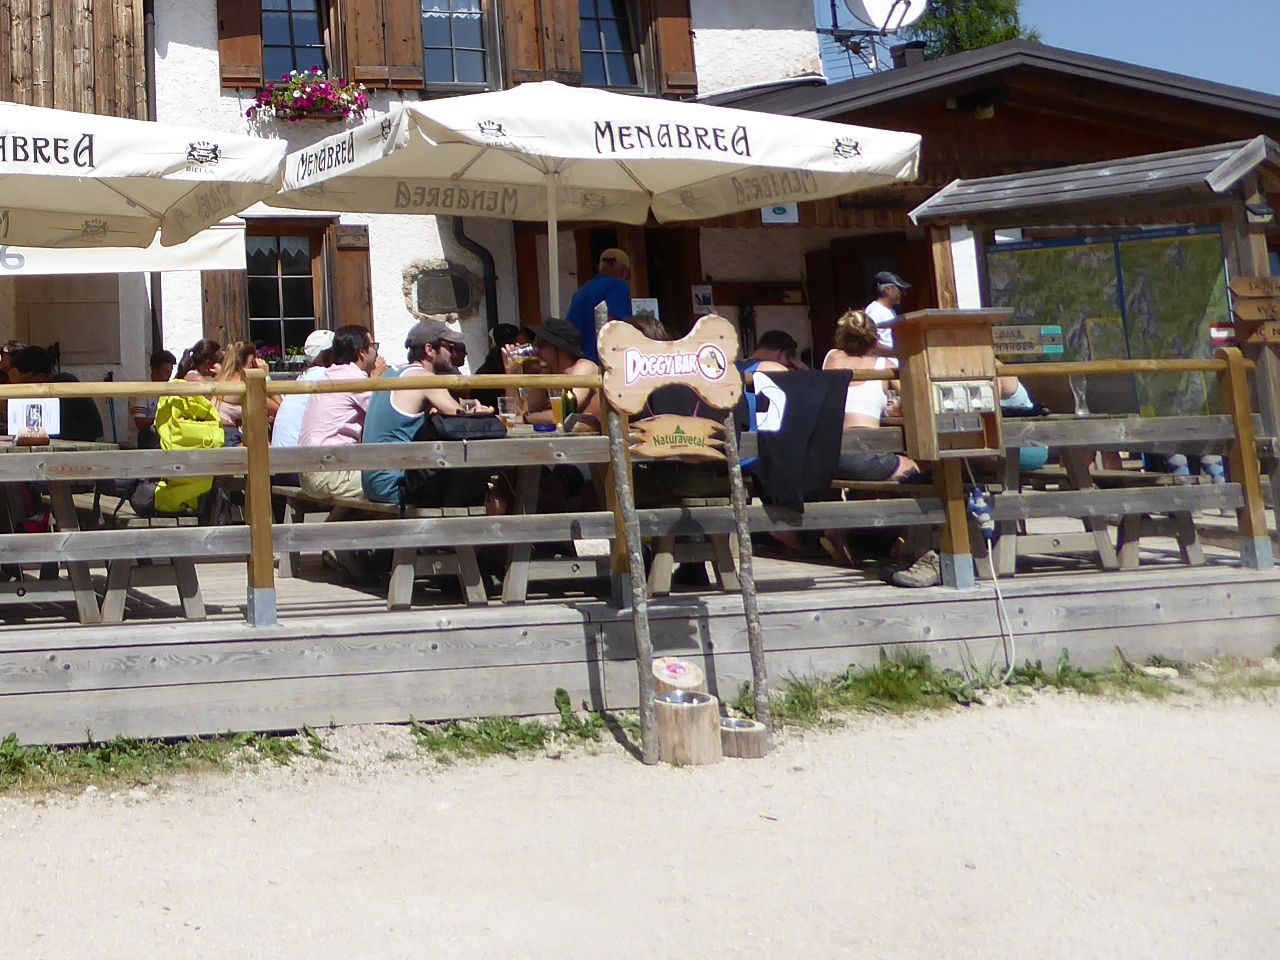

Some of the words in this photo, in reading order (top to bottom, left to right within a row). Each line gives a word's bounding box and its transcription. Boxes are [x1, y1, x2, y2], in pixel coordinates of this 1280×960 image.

[297, 131, 355, 182] MENABREA
[593, 120, 752, 158] MENABREA
[625, 348, 673, 385] DOGGY
[652, 434, 706, 448] Naturavetal
